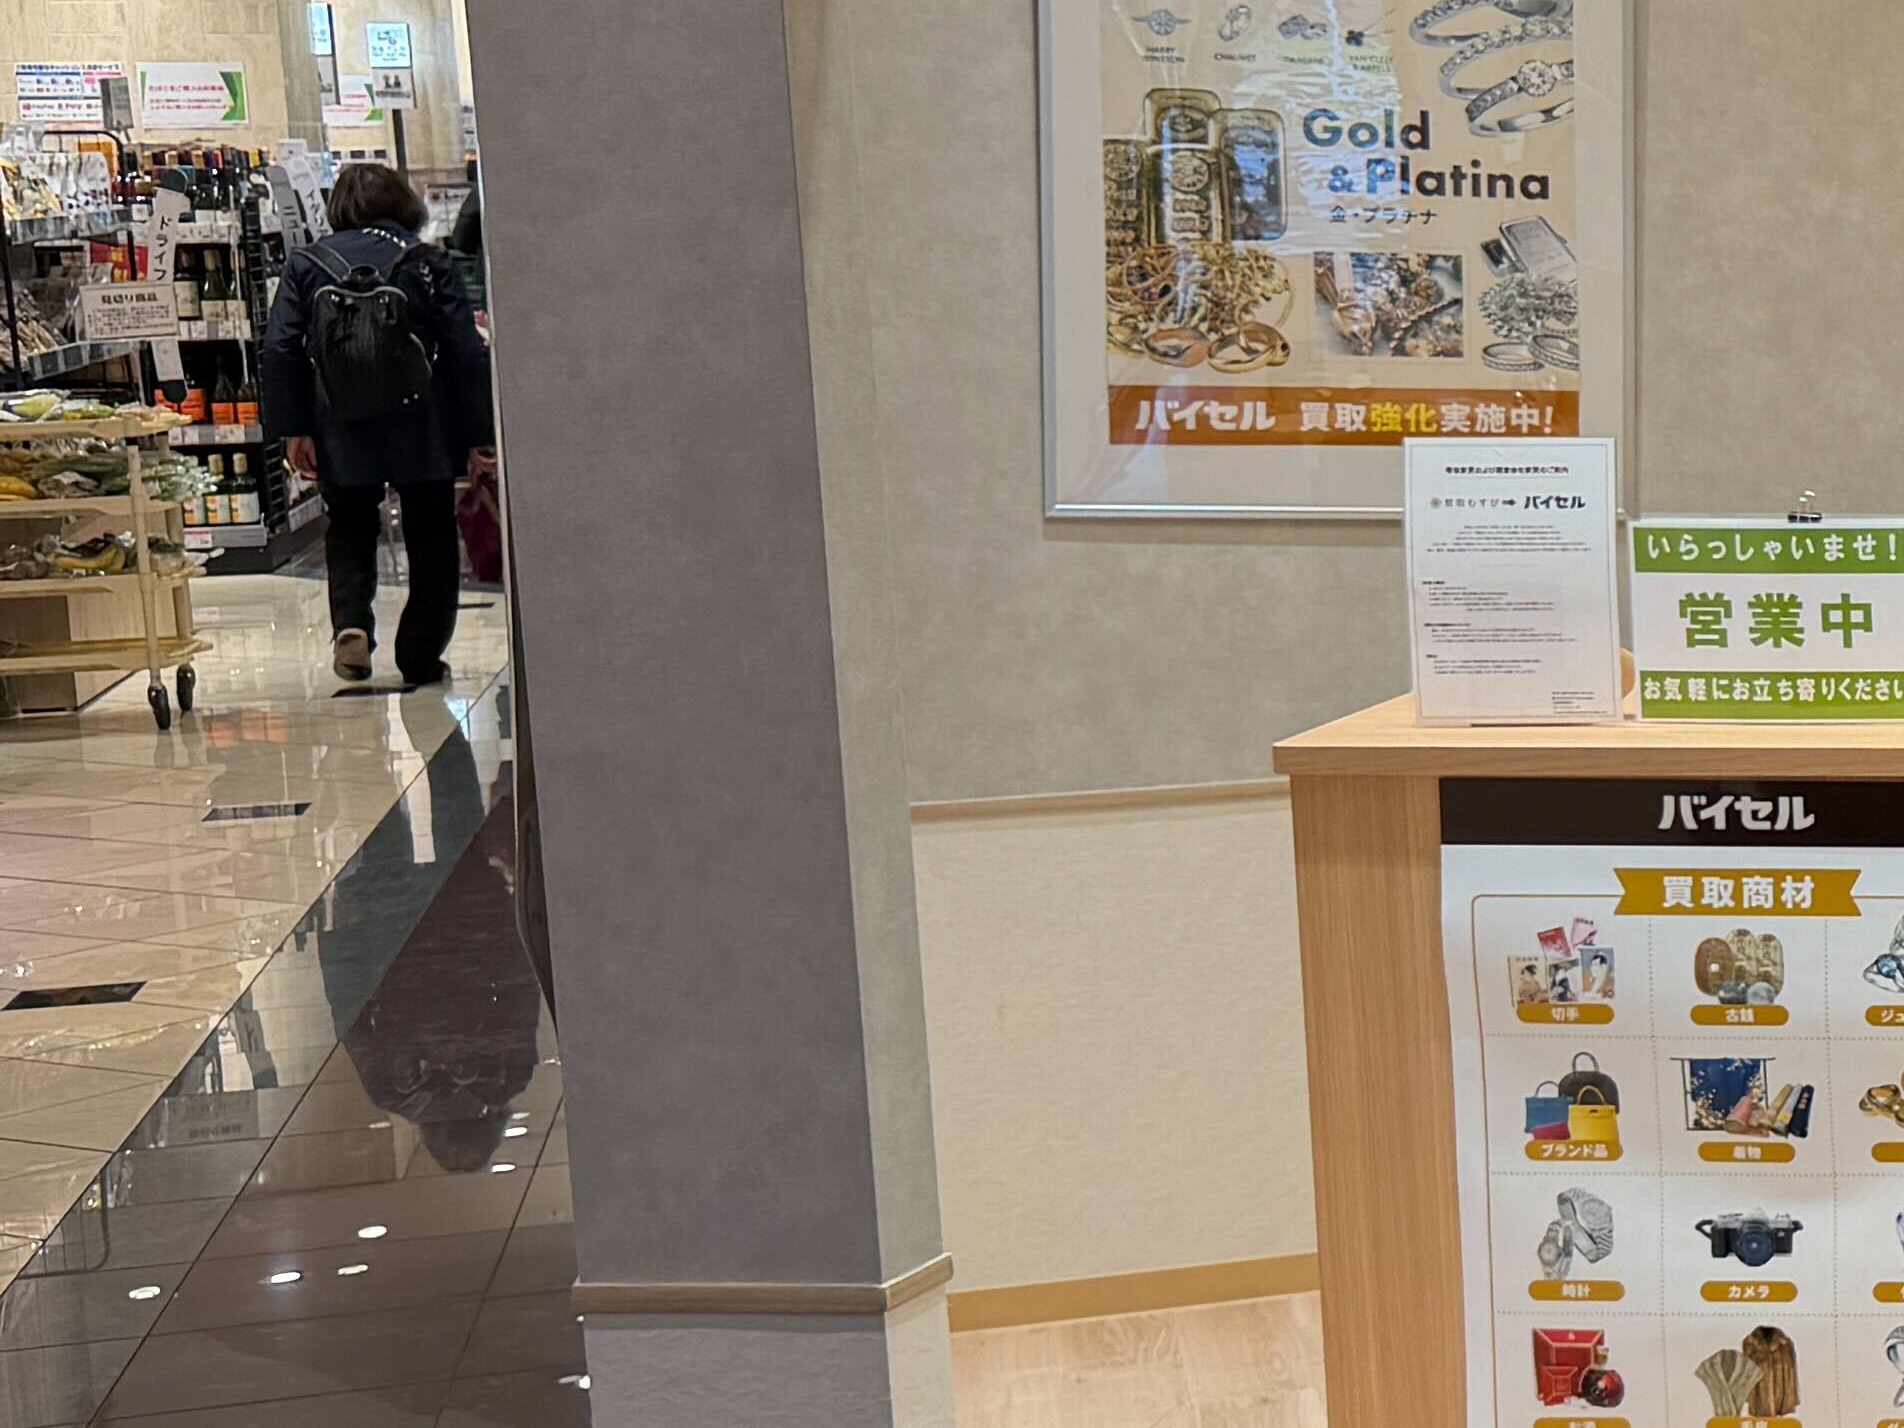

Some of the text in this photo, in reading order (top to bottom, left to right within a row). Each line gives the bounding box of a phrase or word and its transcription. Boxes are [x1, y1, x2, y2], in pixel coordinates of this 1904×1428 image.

[1302, 107, 1432, 152] Gold
[1327, 157, 1551, 201] & Platina
[1135, 399, 1554, 435] バイセル 買取強化実施中!
[1524, 495, 1586, 510] バイセル
[1680, 593, 1875, 650] 営業中
[1657, 794, 1815, 832] バイセル
[1661, 876, 1815, 910] 買取商材
[1552, 1007, 1580, 1023] 切手
[1540, 1142, 1608, 1160] ブランド品
[1728, 1284, 1771, 1300] カメラ
